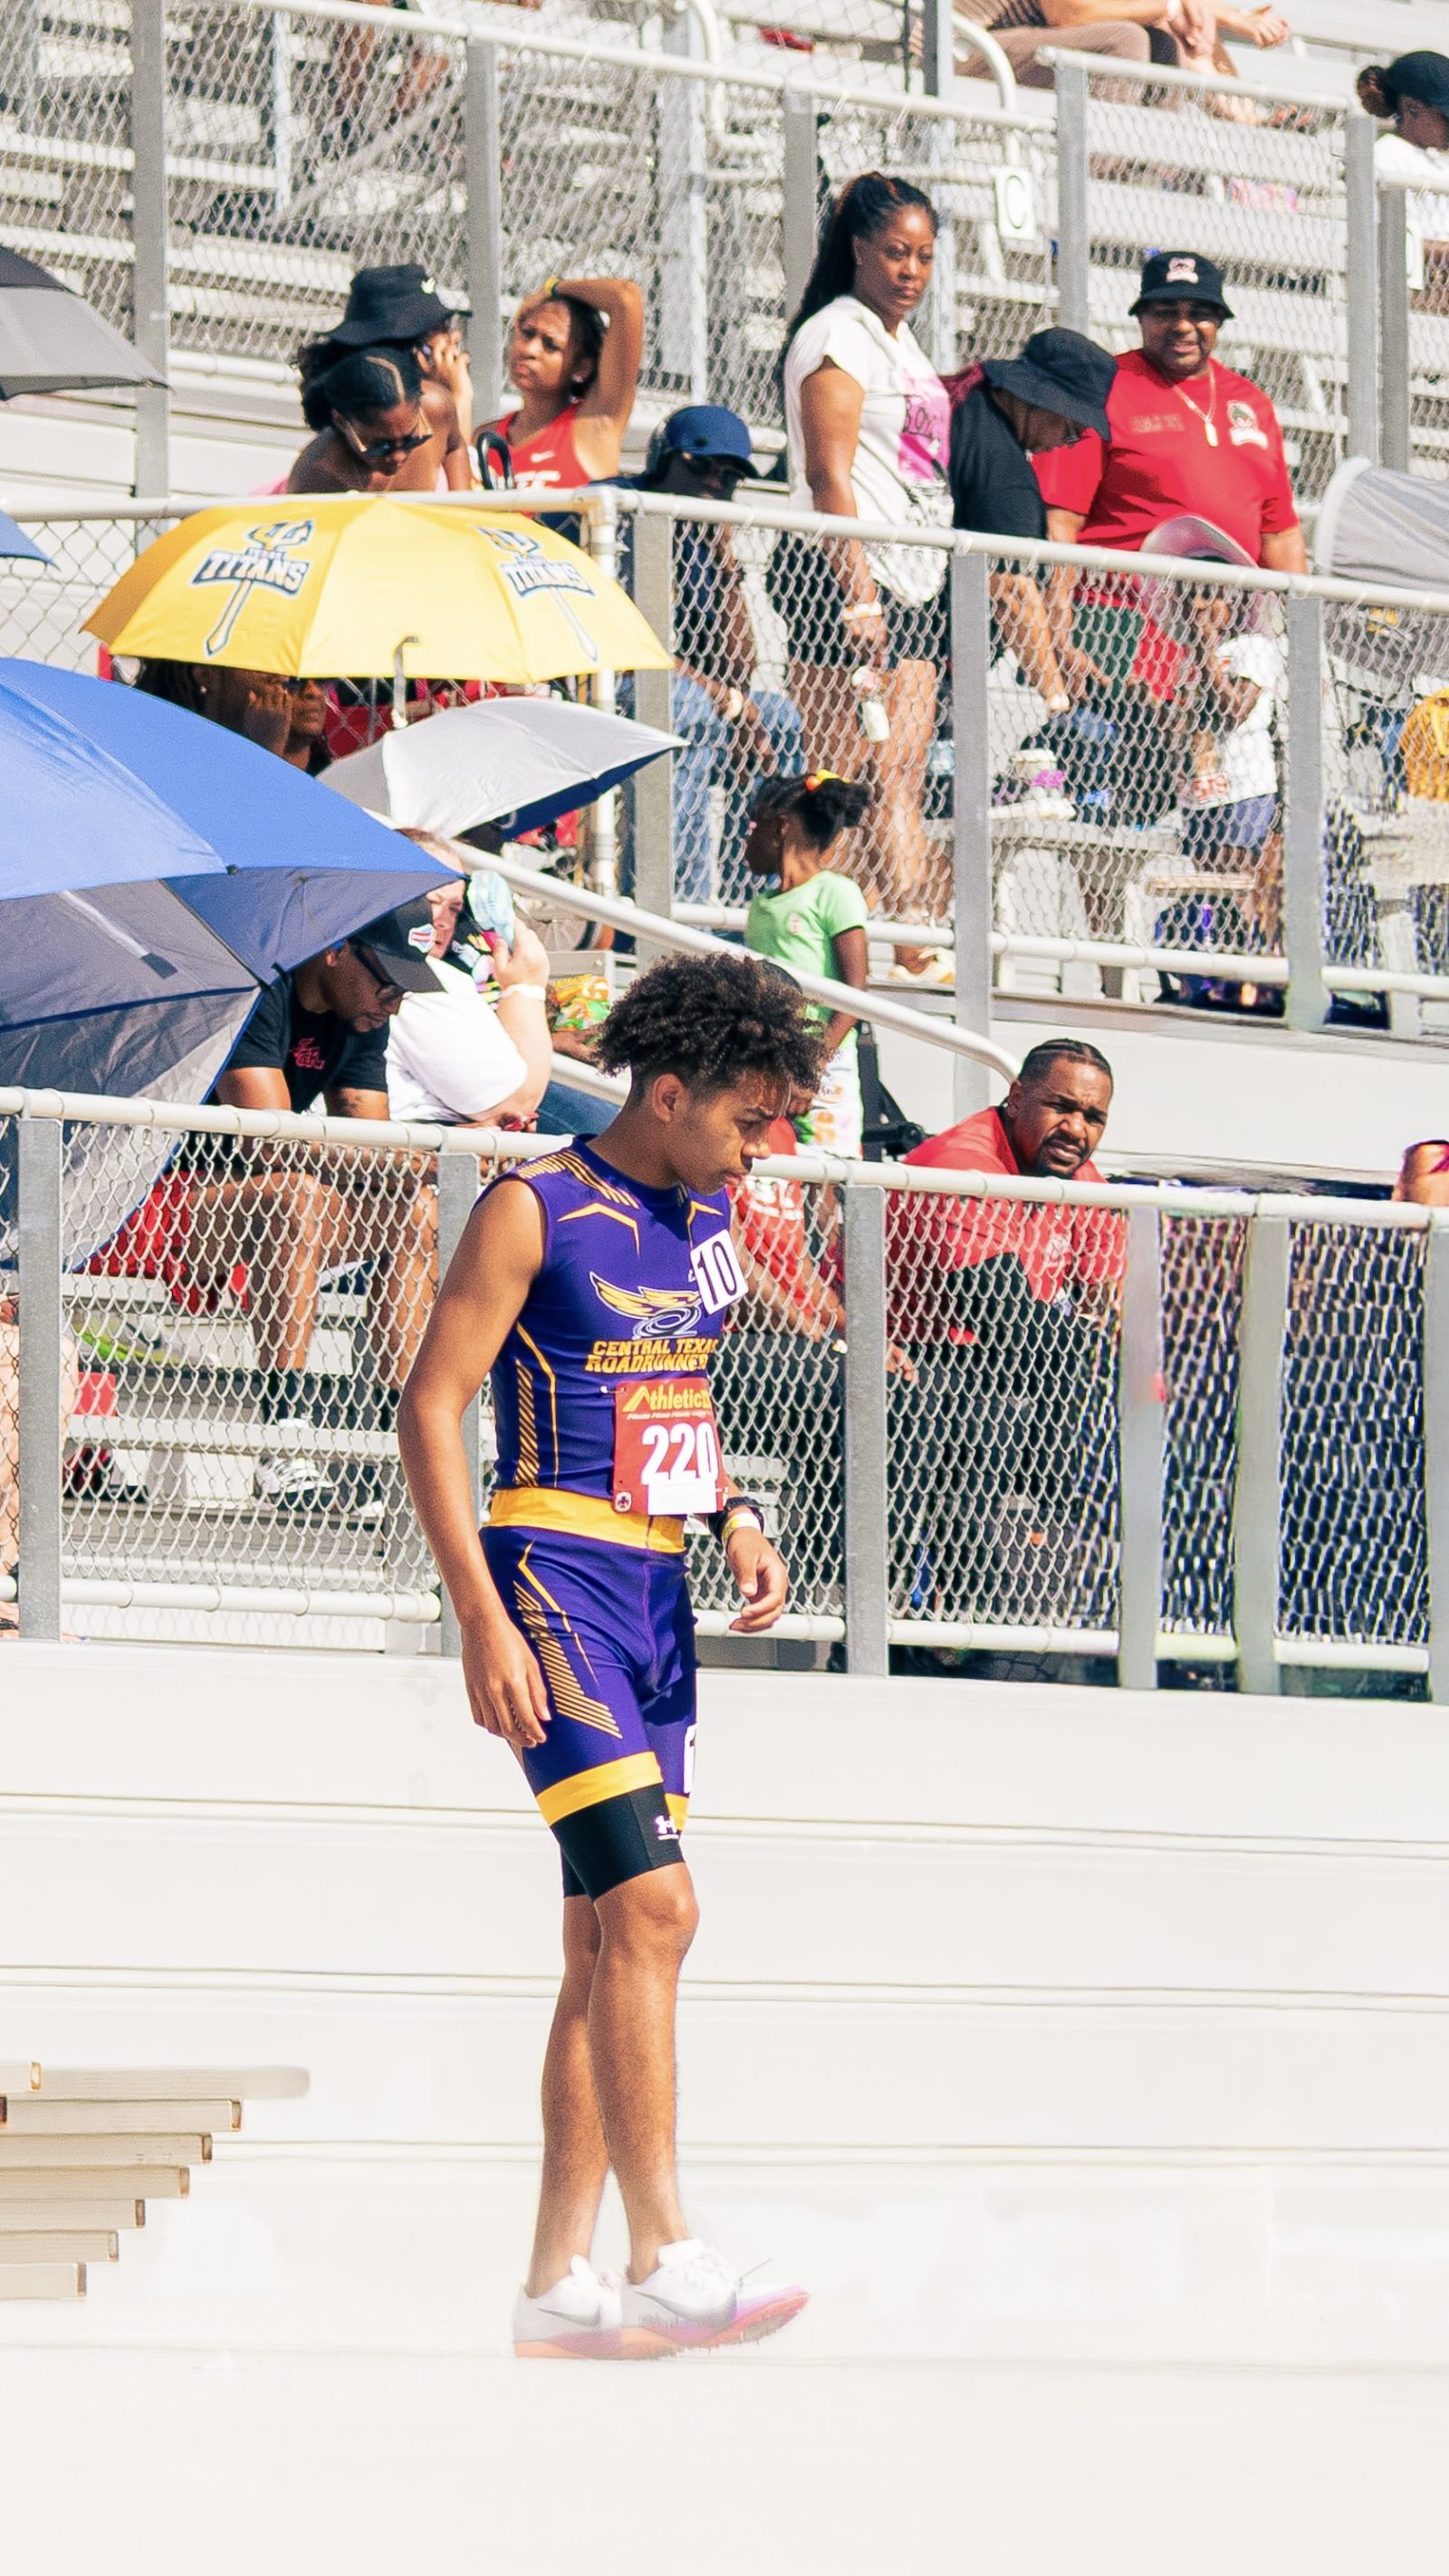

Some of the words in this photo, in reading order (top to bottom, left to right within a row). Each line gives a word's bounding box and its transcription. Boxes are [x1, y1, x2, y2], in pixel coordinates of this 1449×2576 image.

[1003, 175, 1028, 229] C
[193, 551, 309, 594] TITANS
[697, 1240, 737, 1306] 10
[593, 1339, 670, 1356] CENTRAL
[641, 1422, 718, 1485] 220
